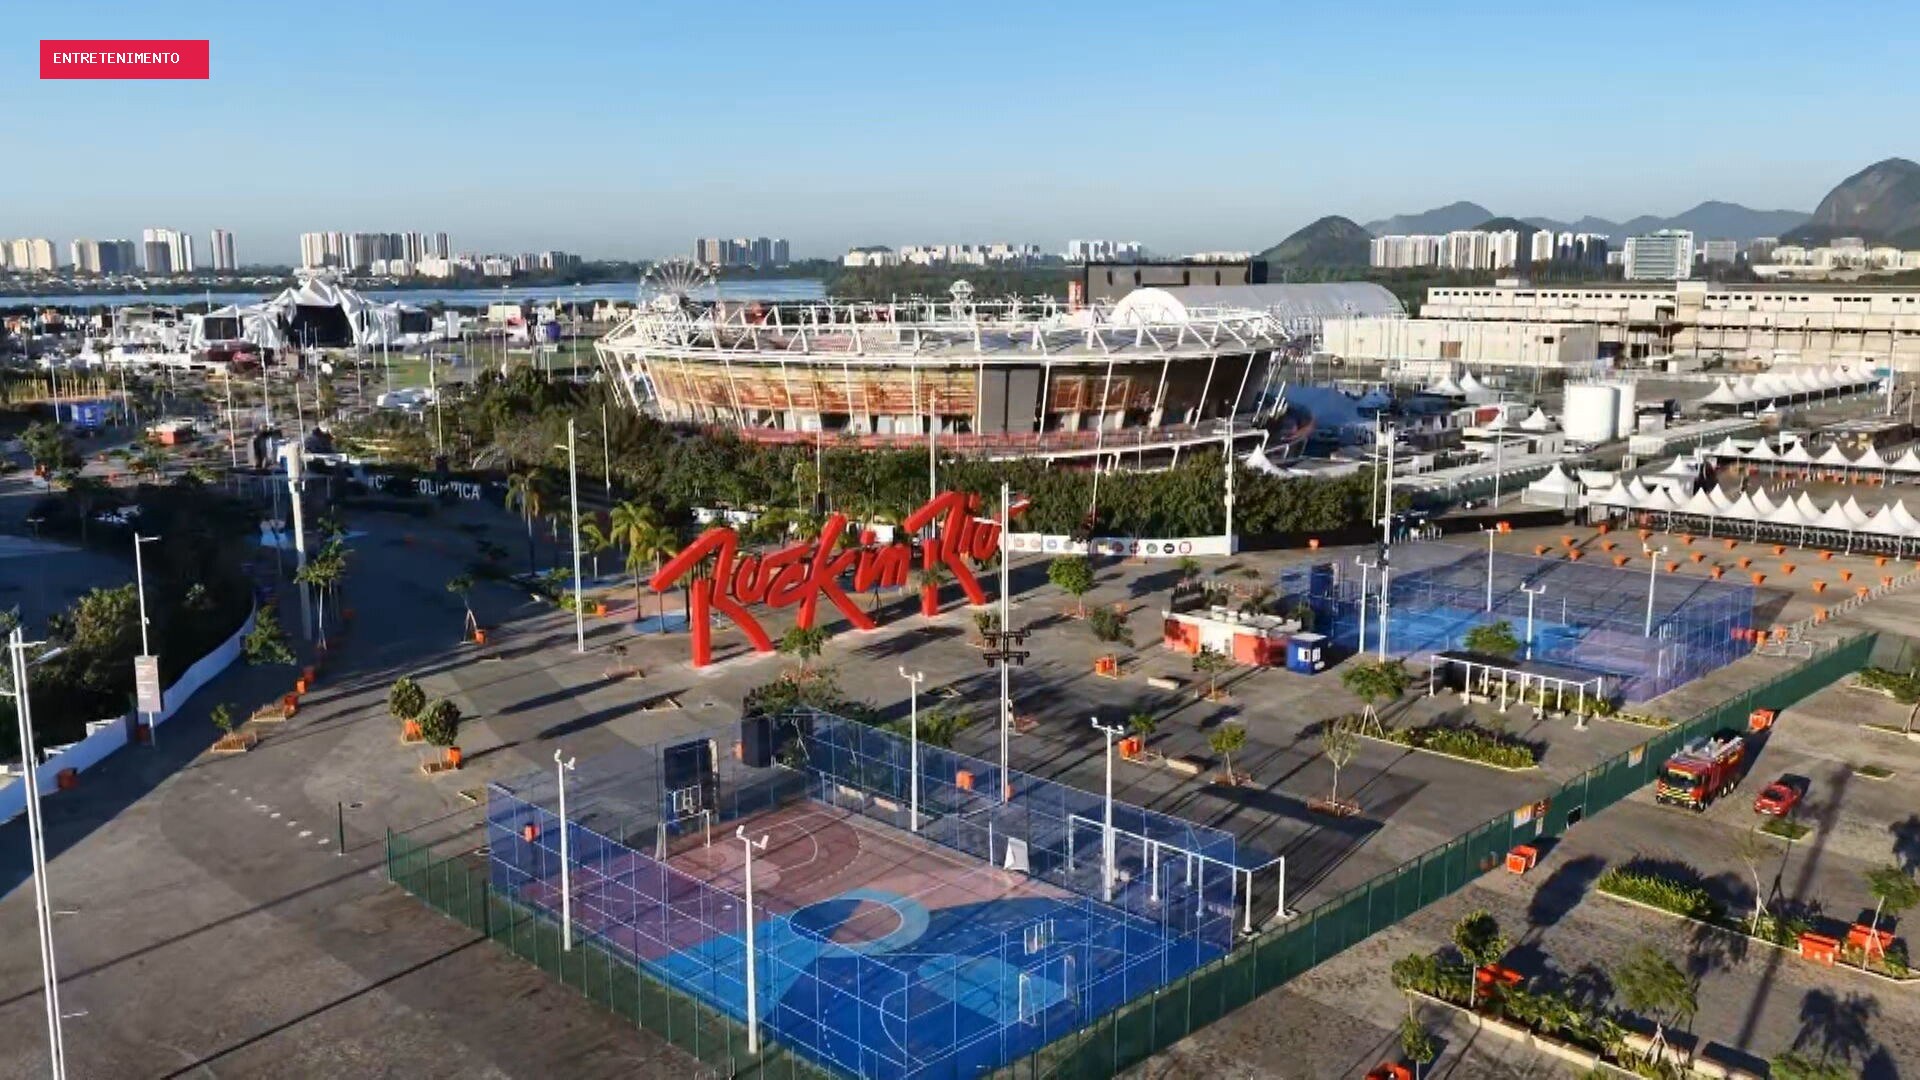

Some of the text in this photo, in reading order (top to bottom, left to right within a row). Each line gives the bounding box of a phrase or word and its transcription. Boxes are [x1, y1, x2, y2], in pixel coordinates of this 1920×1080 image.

[649, 488, 1031, 668] Rock in Rio
